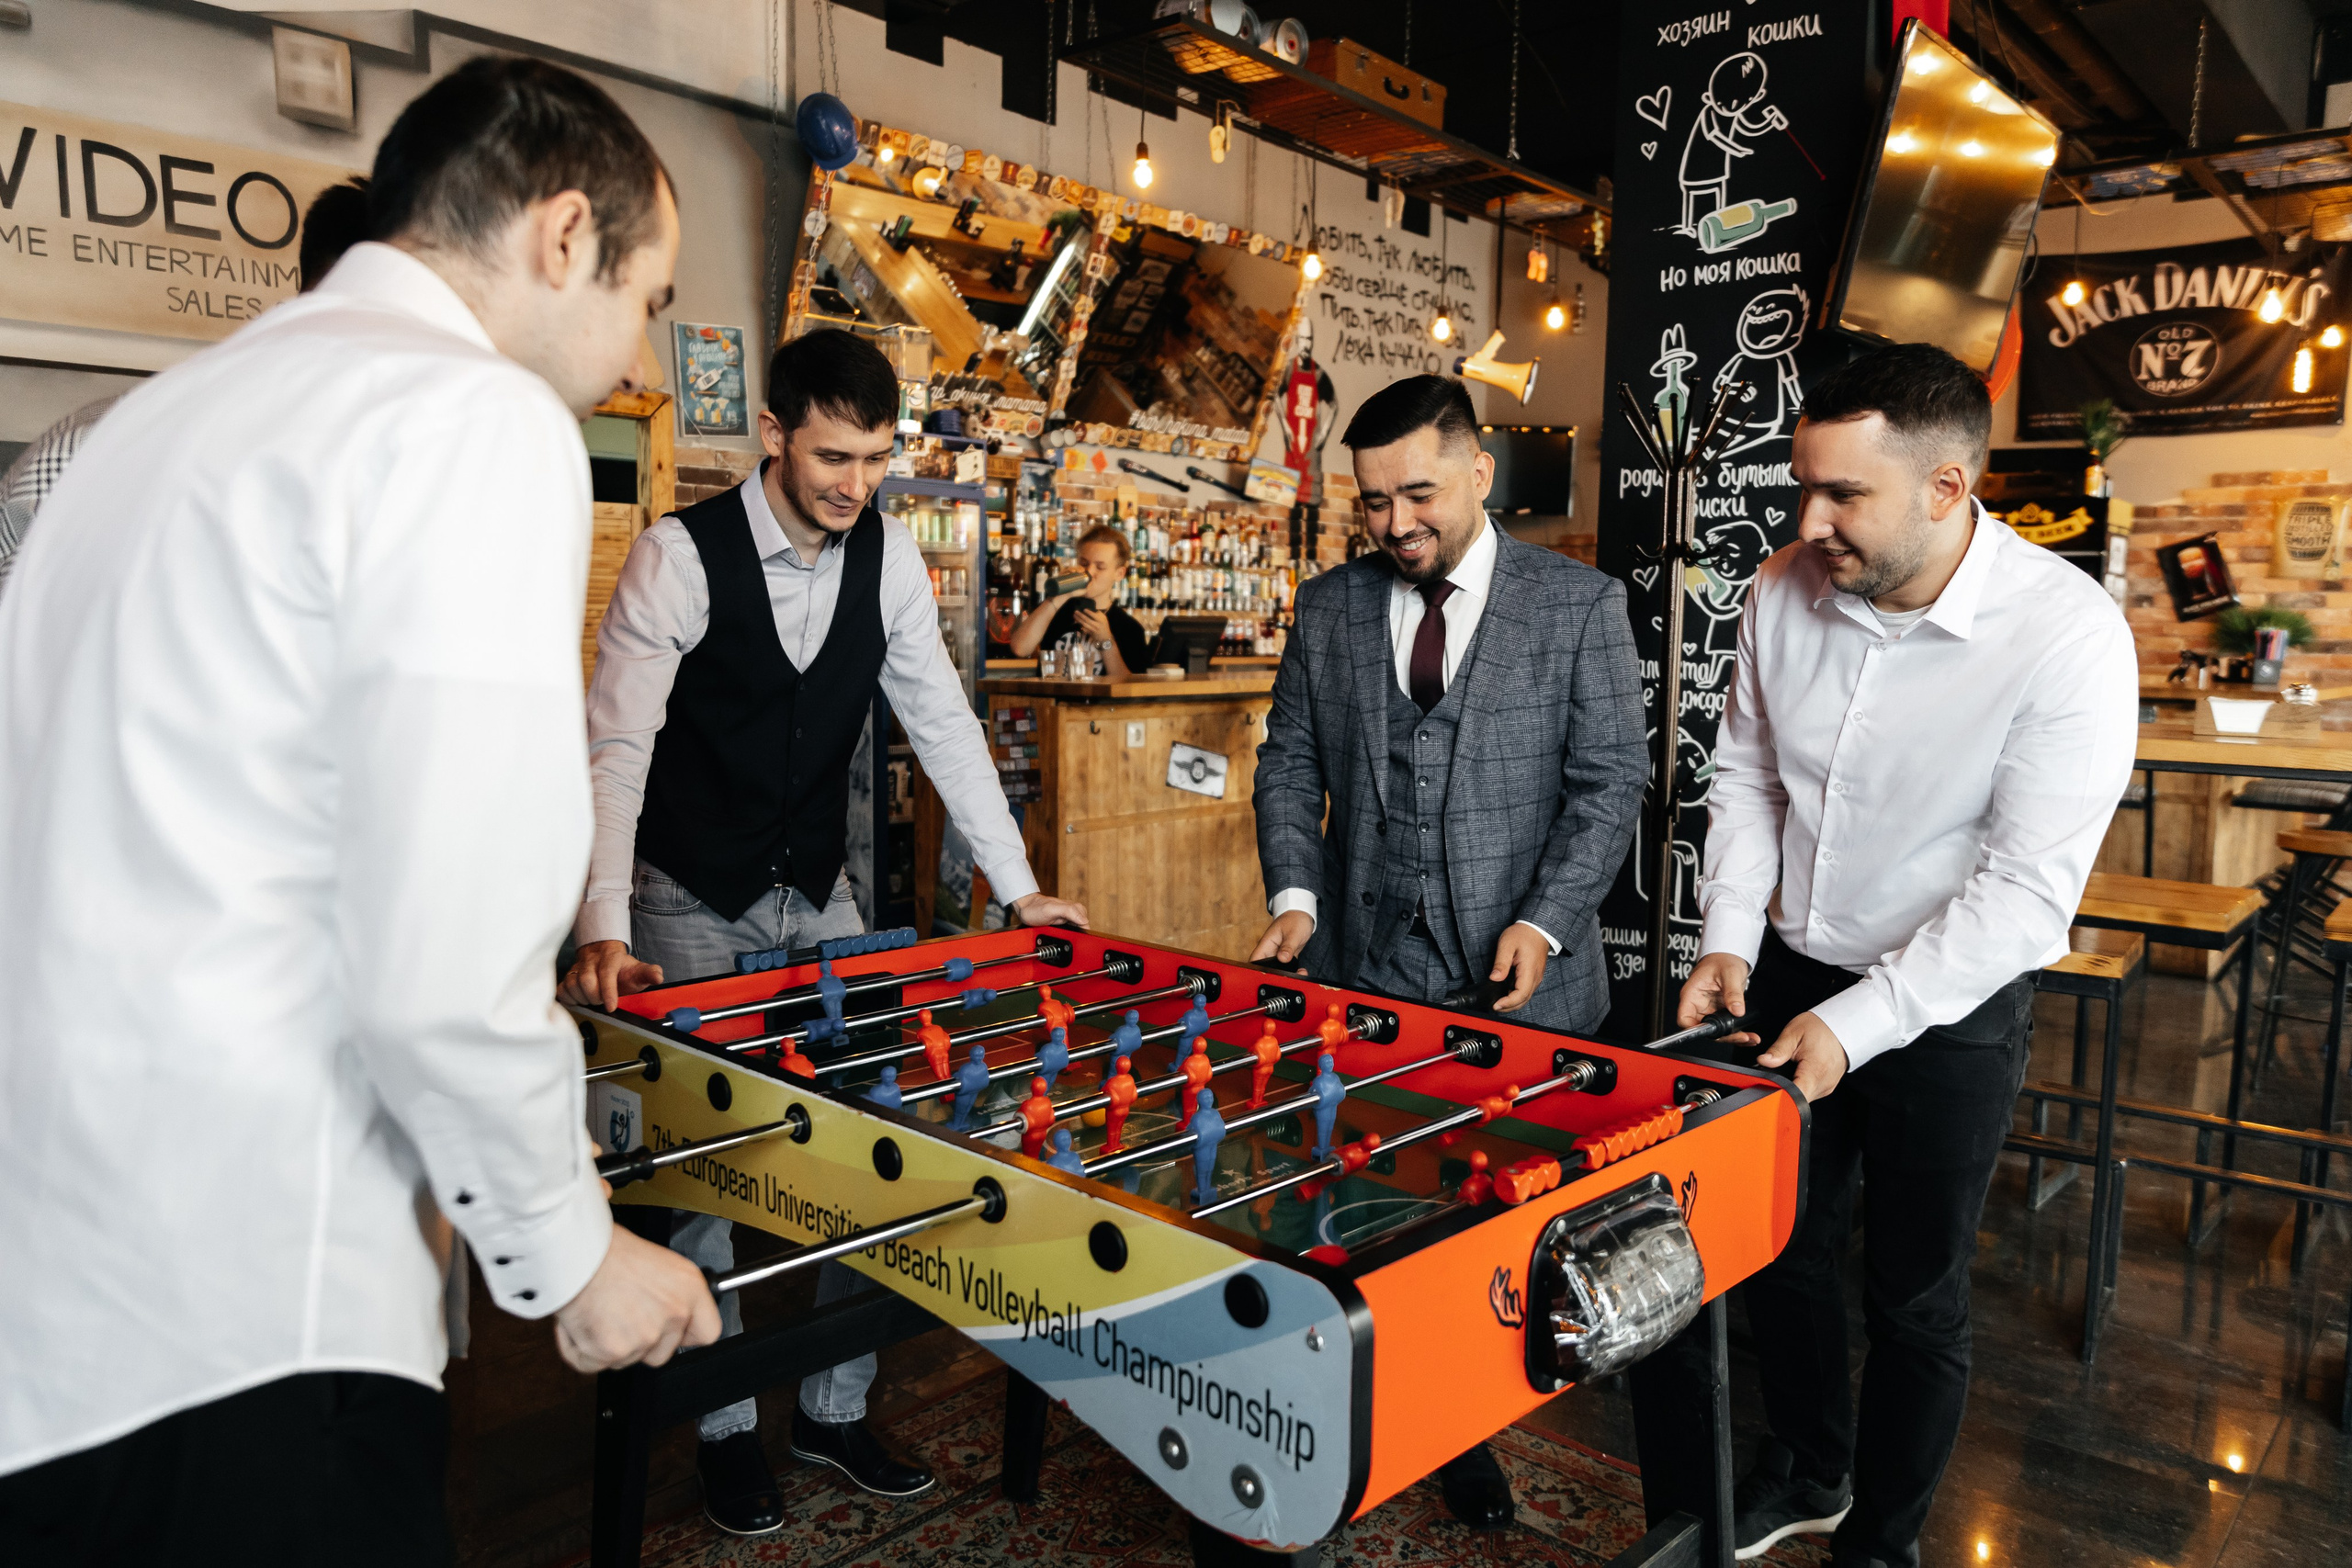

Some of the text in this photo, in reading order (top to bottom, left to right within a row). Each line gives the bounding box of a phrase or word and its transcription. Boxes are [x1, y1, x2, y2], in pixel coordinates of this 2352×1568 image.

[1657, 10, 1824, 49] хозяин кошки
[0, 126, 299, 250] VIDEO
[1694, 260, 1732, 287] моя
[166, 287, 263, 321] SALES
[2045, 276, 2150, 348] JACK
[2157, 327, 2195, 341] OLD
[884, 1238, 951, 1295] Beach
[959, 1256, 1084, 1358] Volleyball
[1094, 1316, 1315, 1472] Championship
